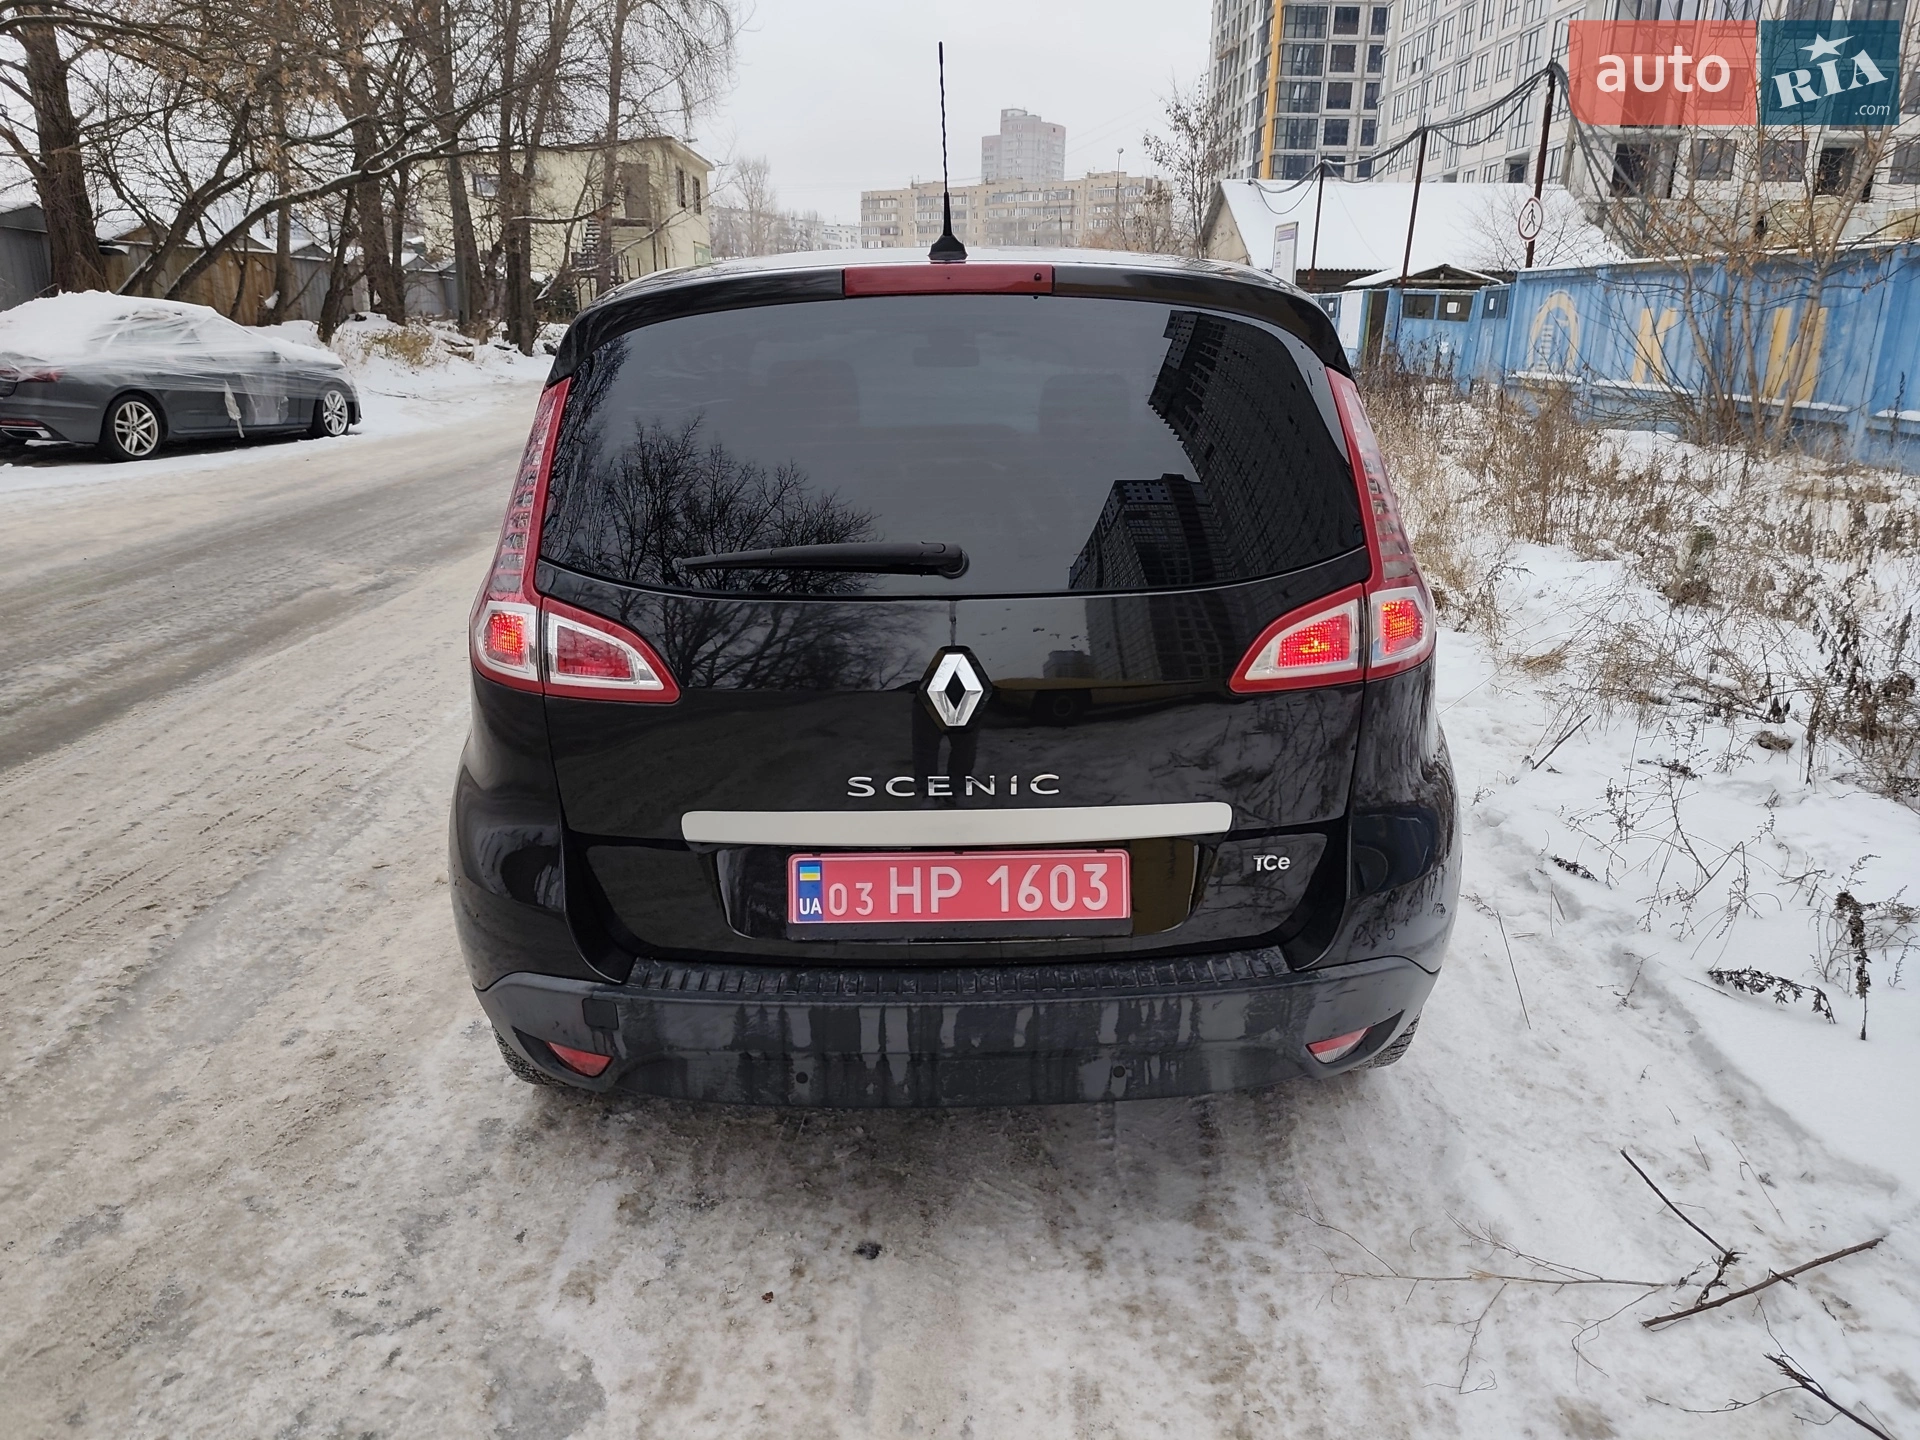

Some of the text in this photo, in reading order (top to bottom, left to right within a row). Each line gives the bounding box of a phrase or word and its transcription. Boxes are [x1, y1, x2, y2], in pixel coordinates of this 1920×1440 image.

[847, 773, 1060, 797] SCENIC
[1253, 854, 1291, 872] TCe
[828, 863, 1109, 916] 03 HP 1603
[799, 898, 823, 915] UA
